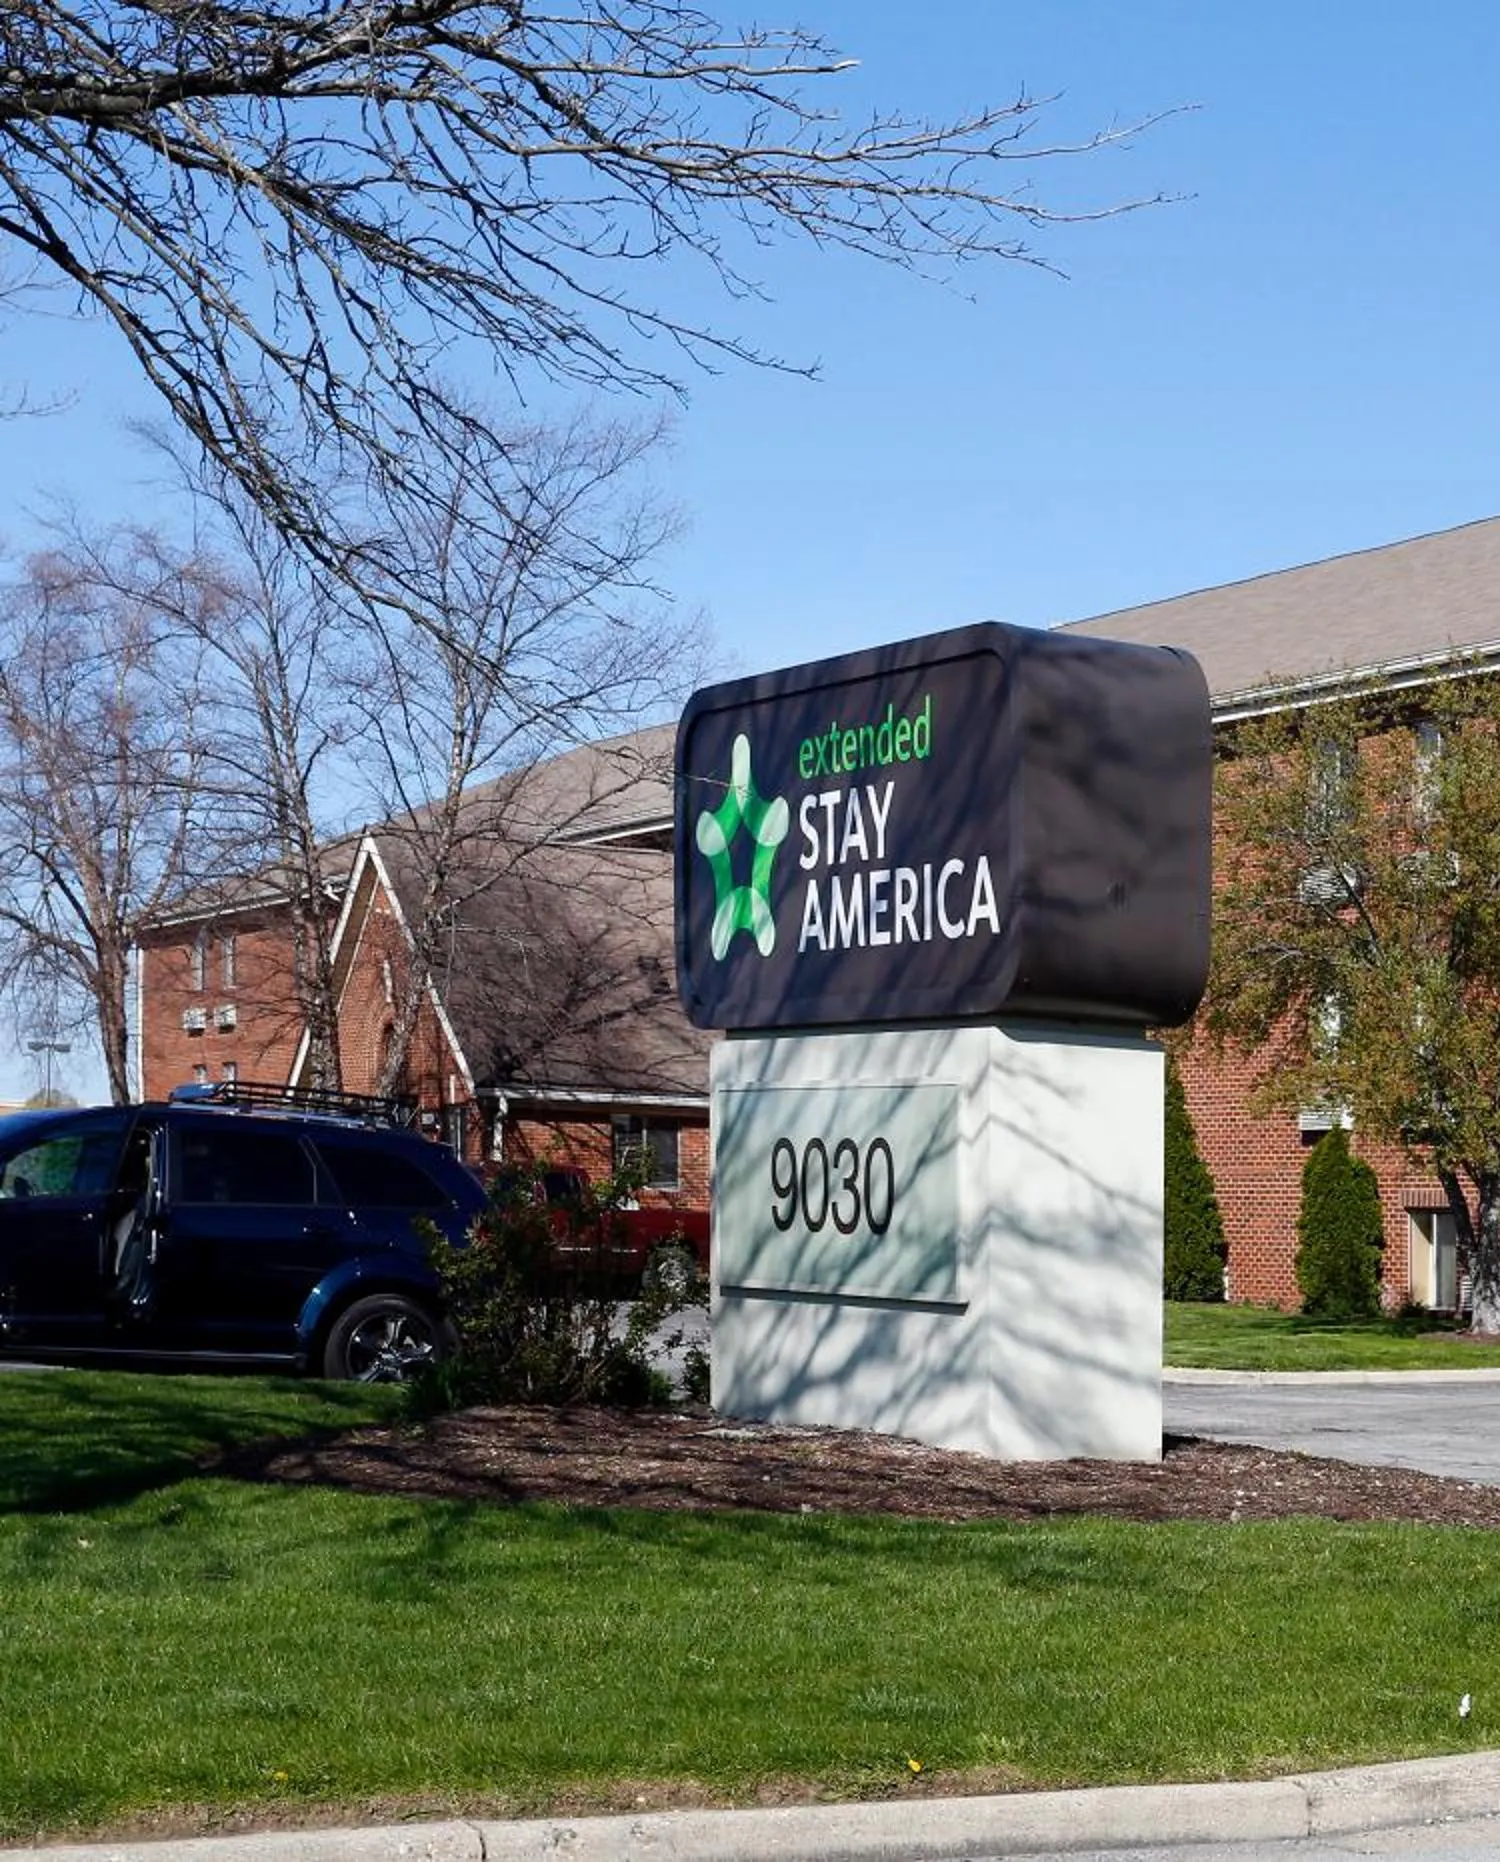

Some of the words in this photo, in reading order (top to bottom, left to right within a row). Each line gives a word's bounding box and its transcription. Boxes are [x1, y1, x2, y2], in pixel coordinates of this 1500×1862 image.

[799, 694, 931, 779] extended
[799, 781, 895, 869] STAY
[798, 855, 1000, 953] AMERICA
[771, 1137, 894, 1235] 9030
